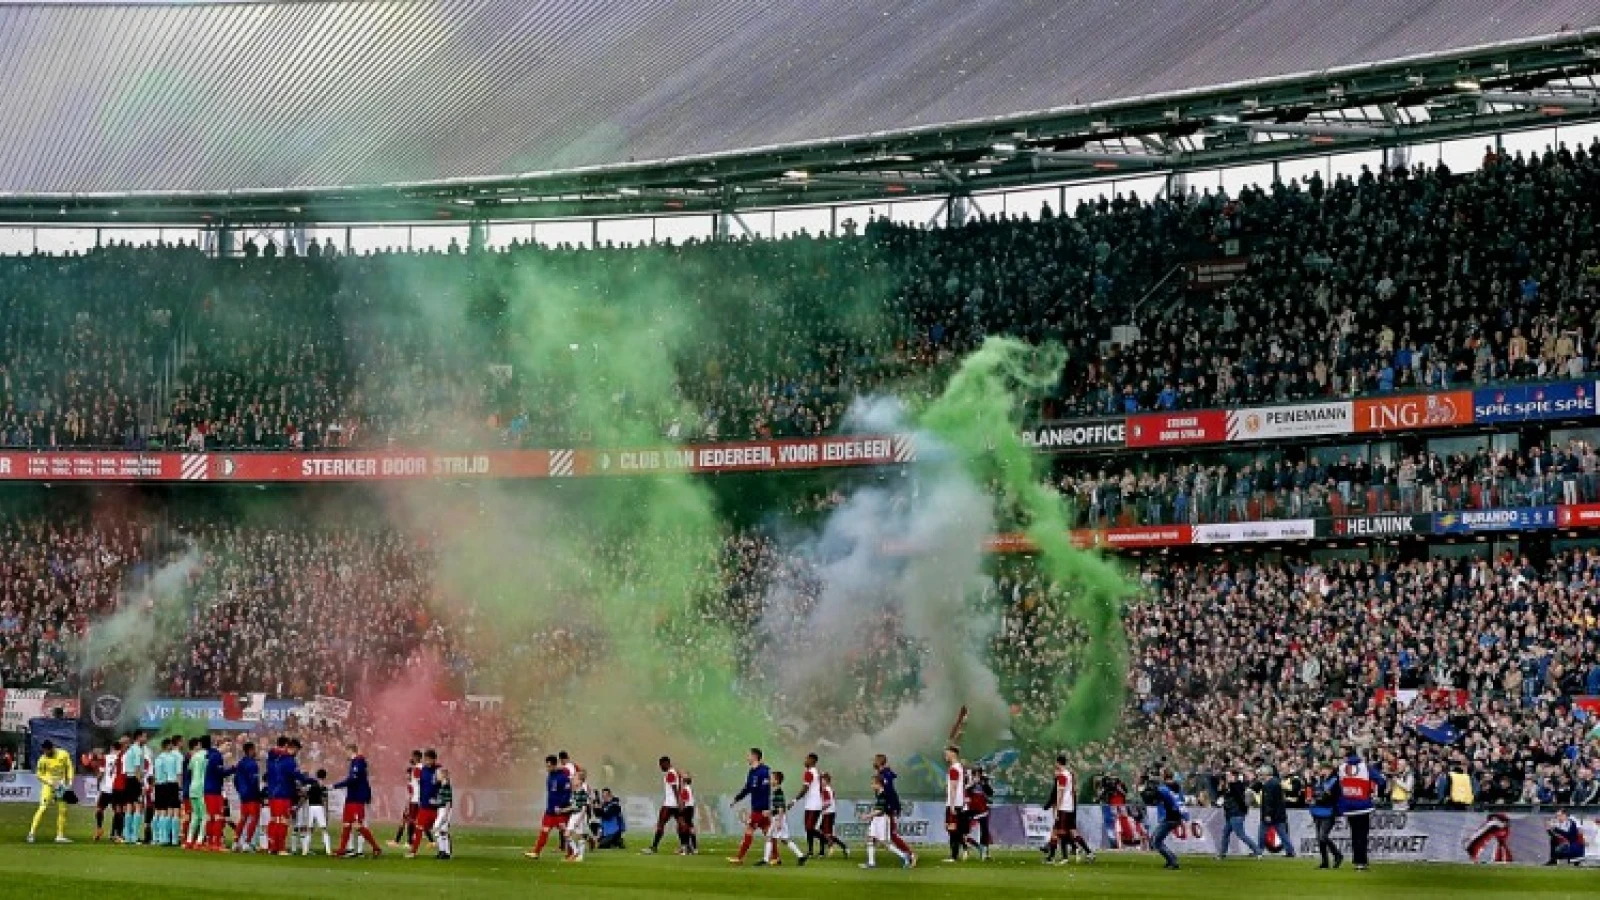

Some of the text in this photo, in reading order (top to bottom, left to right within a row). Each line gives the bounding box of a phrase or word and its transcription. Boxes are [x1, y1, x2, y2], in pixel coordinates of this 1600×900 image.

[1475, 404, 1508, 418] SPIE
[1514, 400, 1551, 415] SPIE
[1554, 397, 1594, 411] SPIE
[1266, 407, 1347, 424] PEINEMANN
[1368, 403, 1419, 429] ING
[1021, 424, 1127, 447] PLAN@OFFICE
[620, 439, 891, 469] CLUB VAN IEDEREEN, VOOR IEDEREEN
[302, 455, 489, 476] STERKER DOOR STRIJD
[1346, 516, 1413, 534] HELMINK
